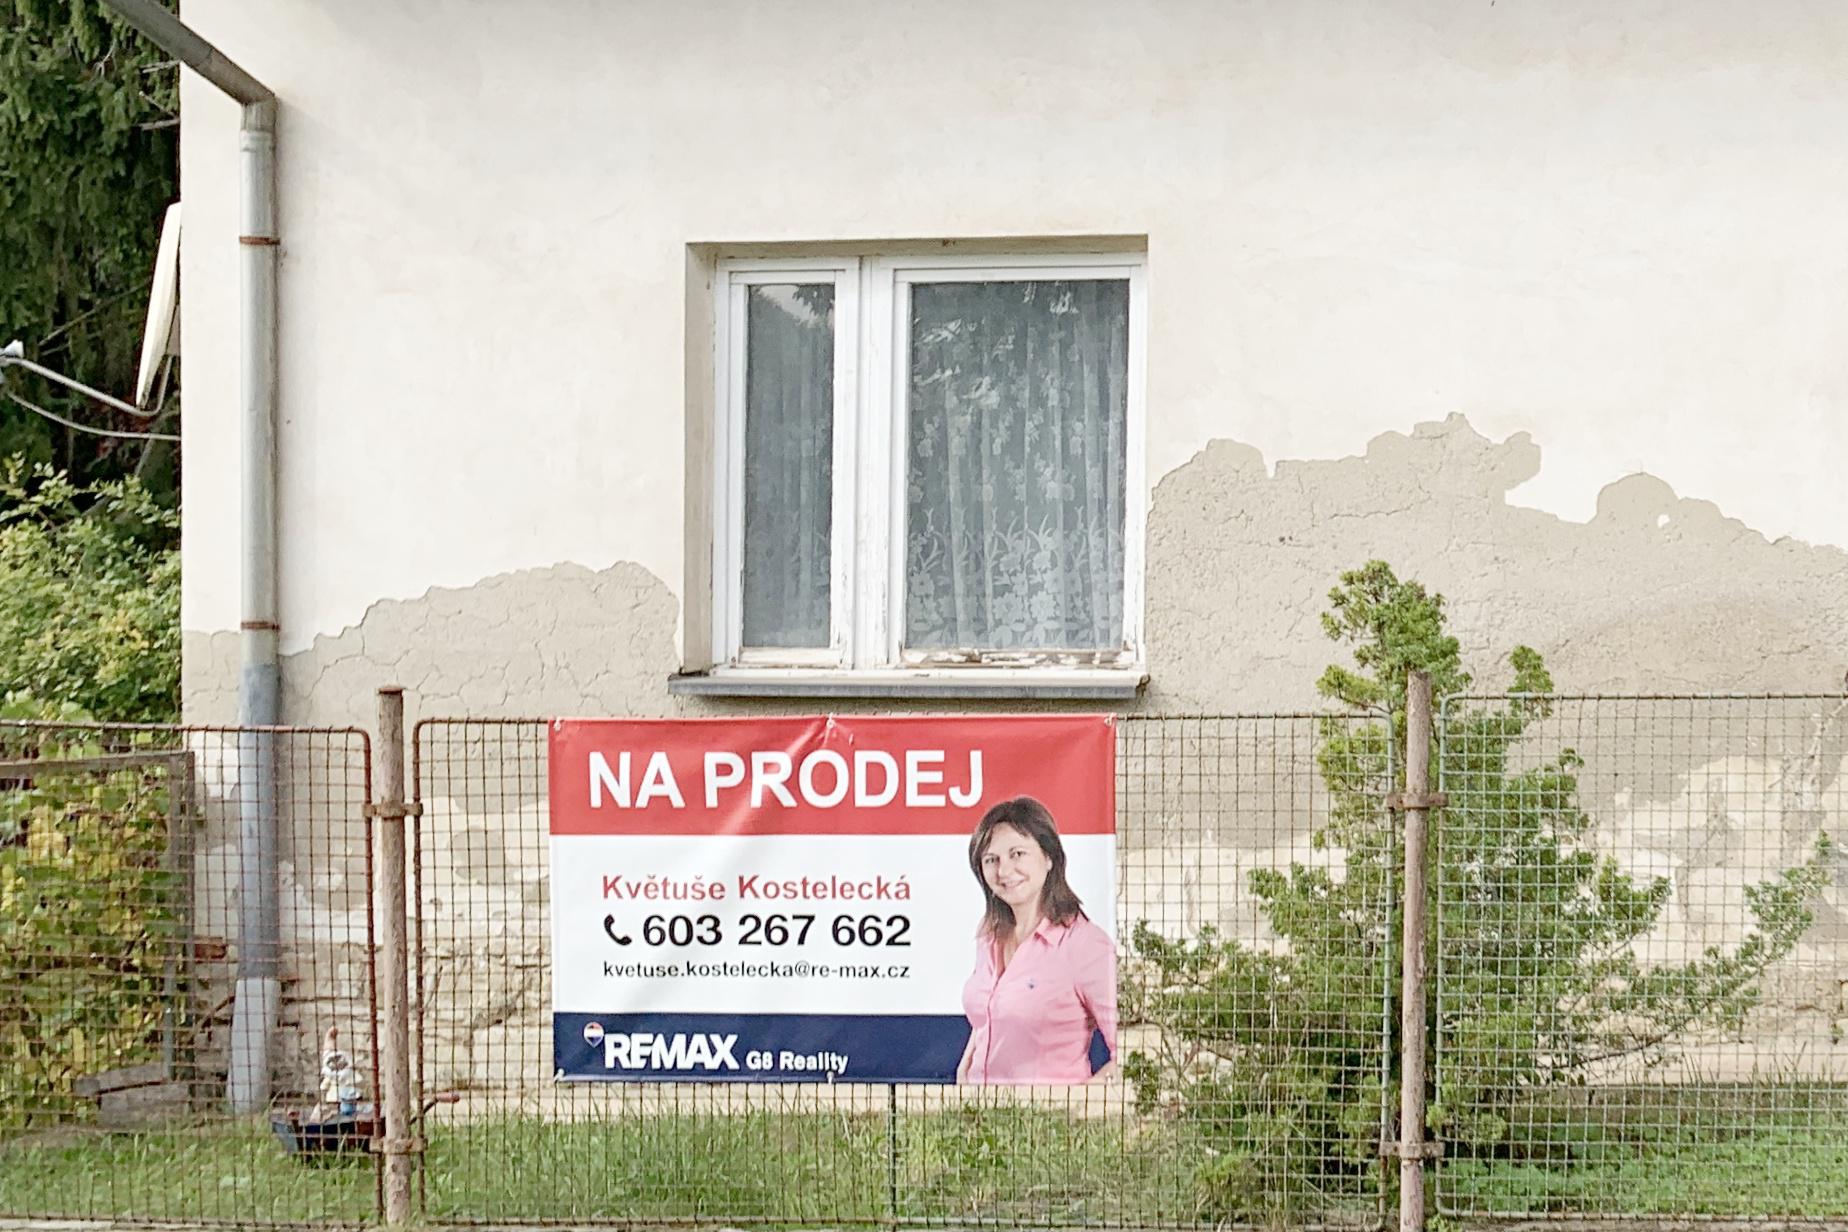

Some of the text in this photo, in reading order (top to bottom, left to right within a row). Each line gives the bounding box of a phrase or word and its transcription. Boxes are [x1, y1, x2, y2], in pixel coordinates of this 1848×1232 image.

[588, 749, 983, 809] NA PRODEJ
[602, 874, 911, 901] Květuše Kostelecká
[643, 914, 912, 947] 603 267 662
[603, 960, 911, 979] kvetuse.kostelecka@re-max.cz
[745, 1050, 774, 1071] G8
